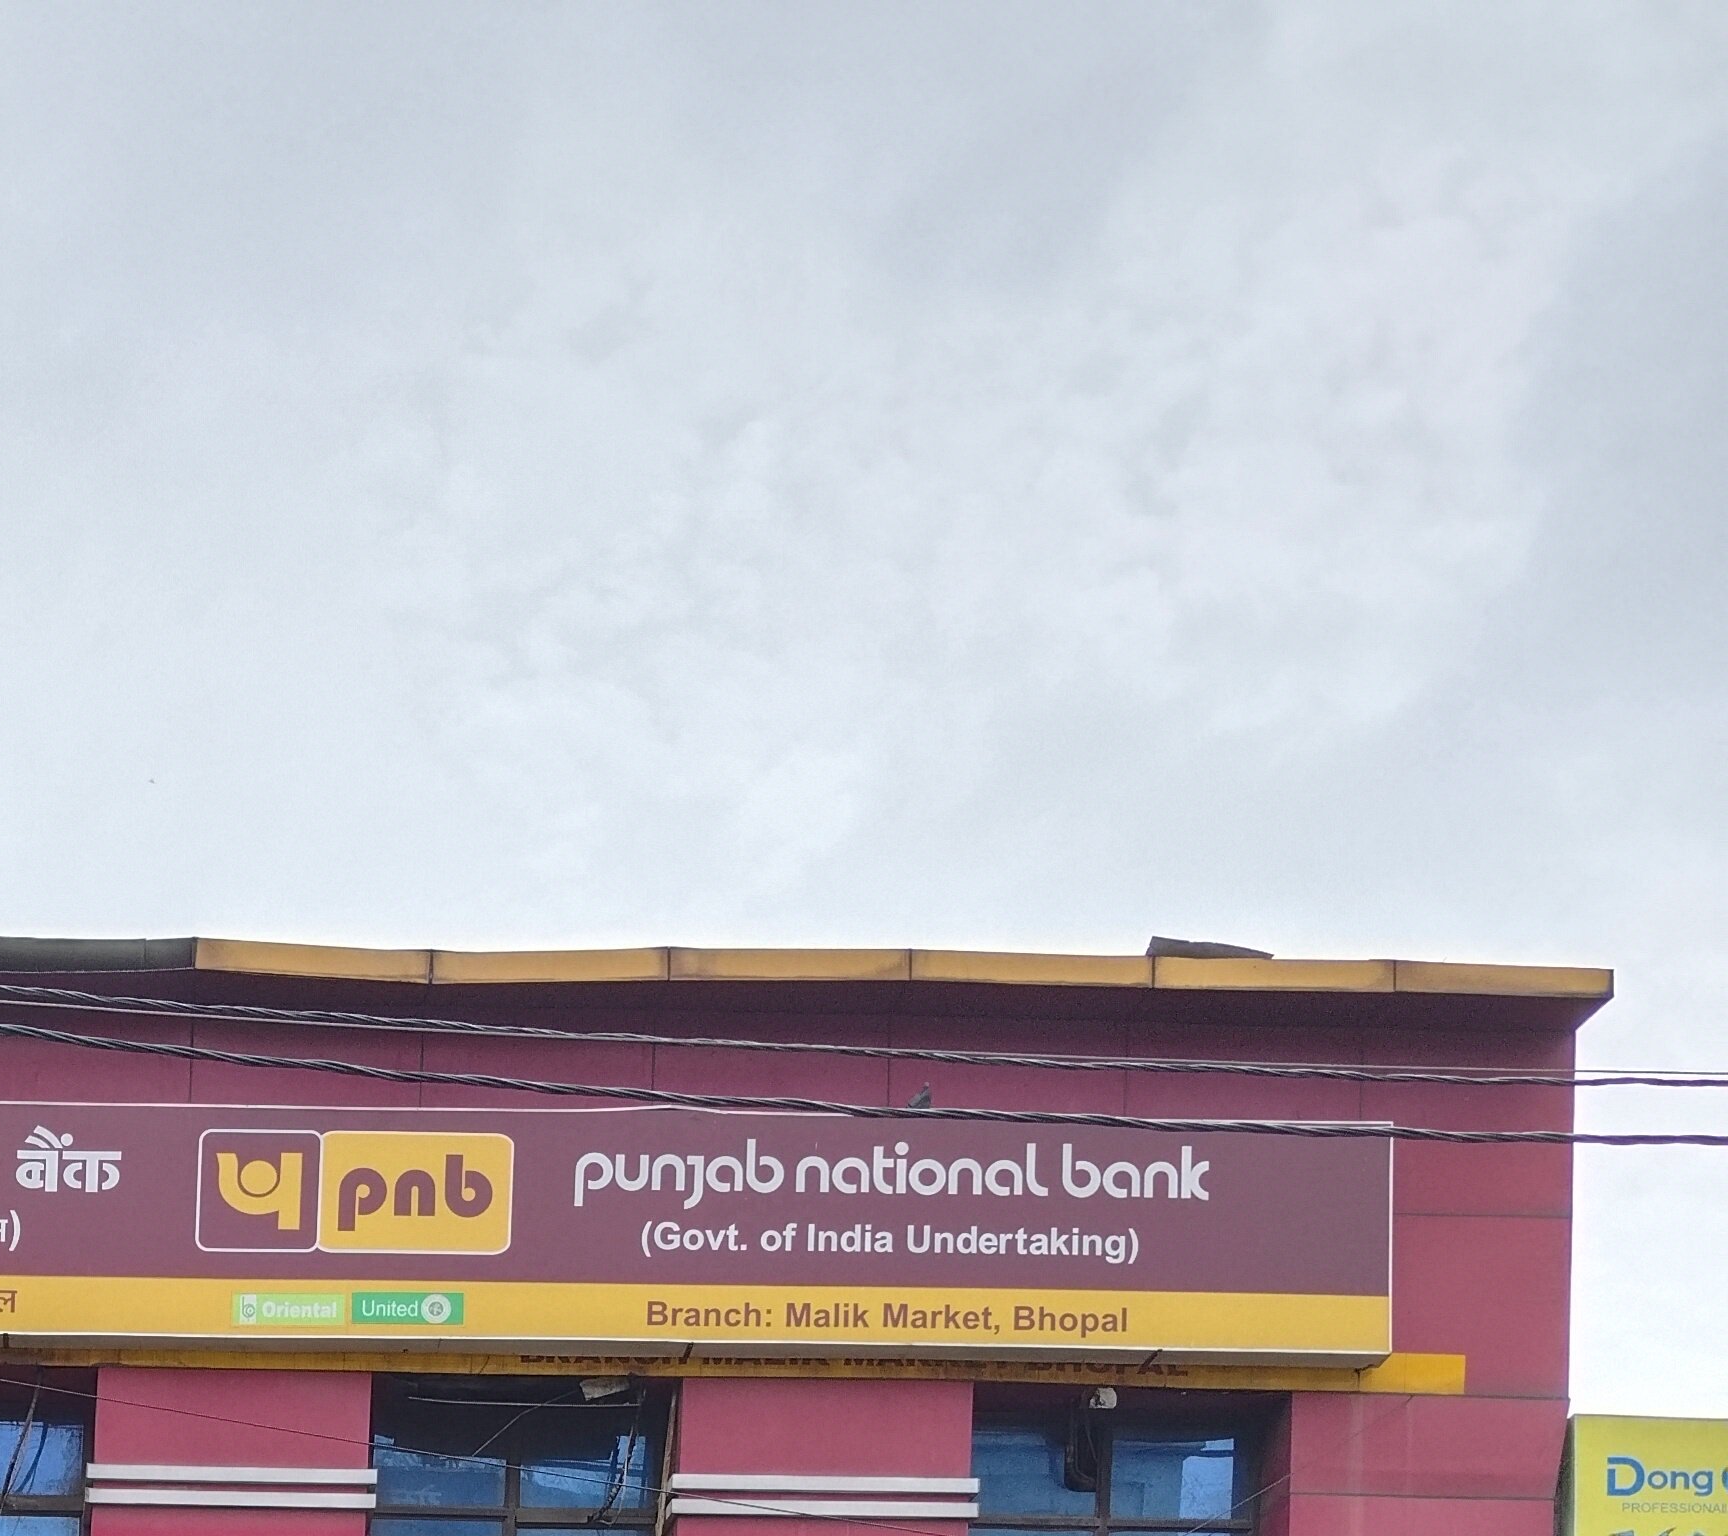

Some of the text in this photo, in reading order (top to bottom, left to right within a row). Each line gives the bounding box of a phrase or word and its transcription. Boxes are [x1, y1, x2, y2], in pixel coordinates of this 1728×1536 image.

[15, 1125, 122, 1193] बैंक
[574, 1139, 1210, 1209] punjab national bank
[337, 1154, 493, 1232] pnb
[641, 1223, 1140, 1265] (Govt. of India Undertaking)
[262, 1301, 337, 1318] Oriental
[362, 1300, 418, 1317] United
[646, 1300, 1129, 1338] Branch: Malik Market, Bhopal
[1607, 1457, 1713, 1496] Dong
